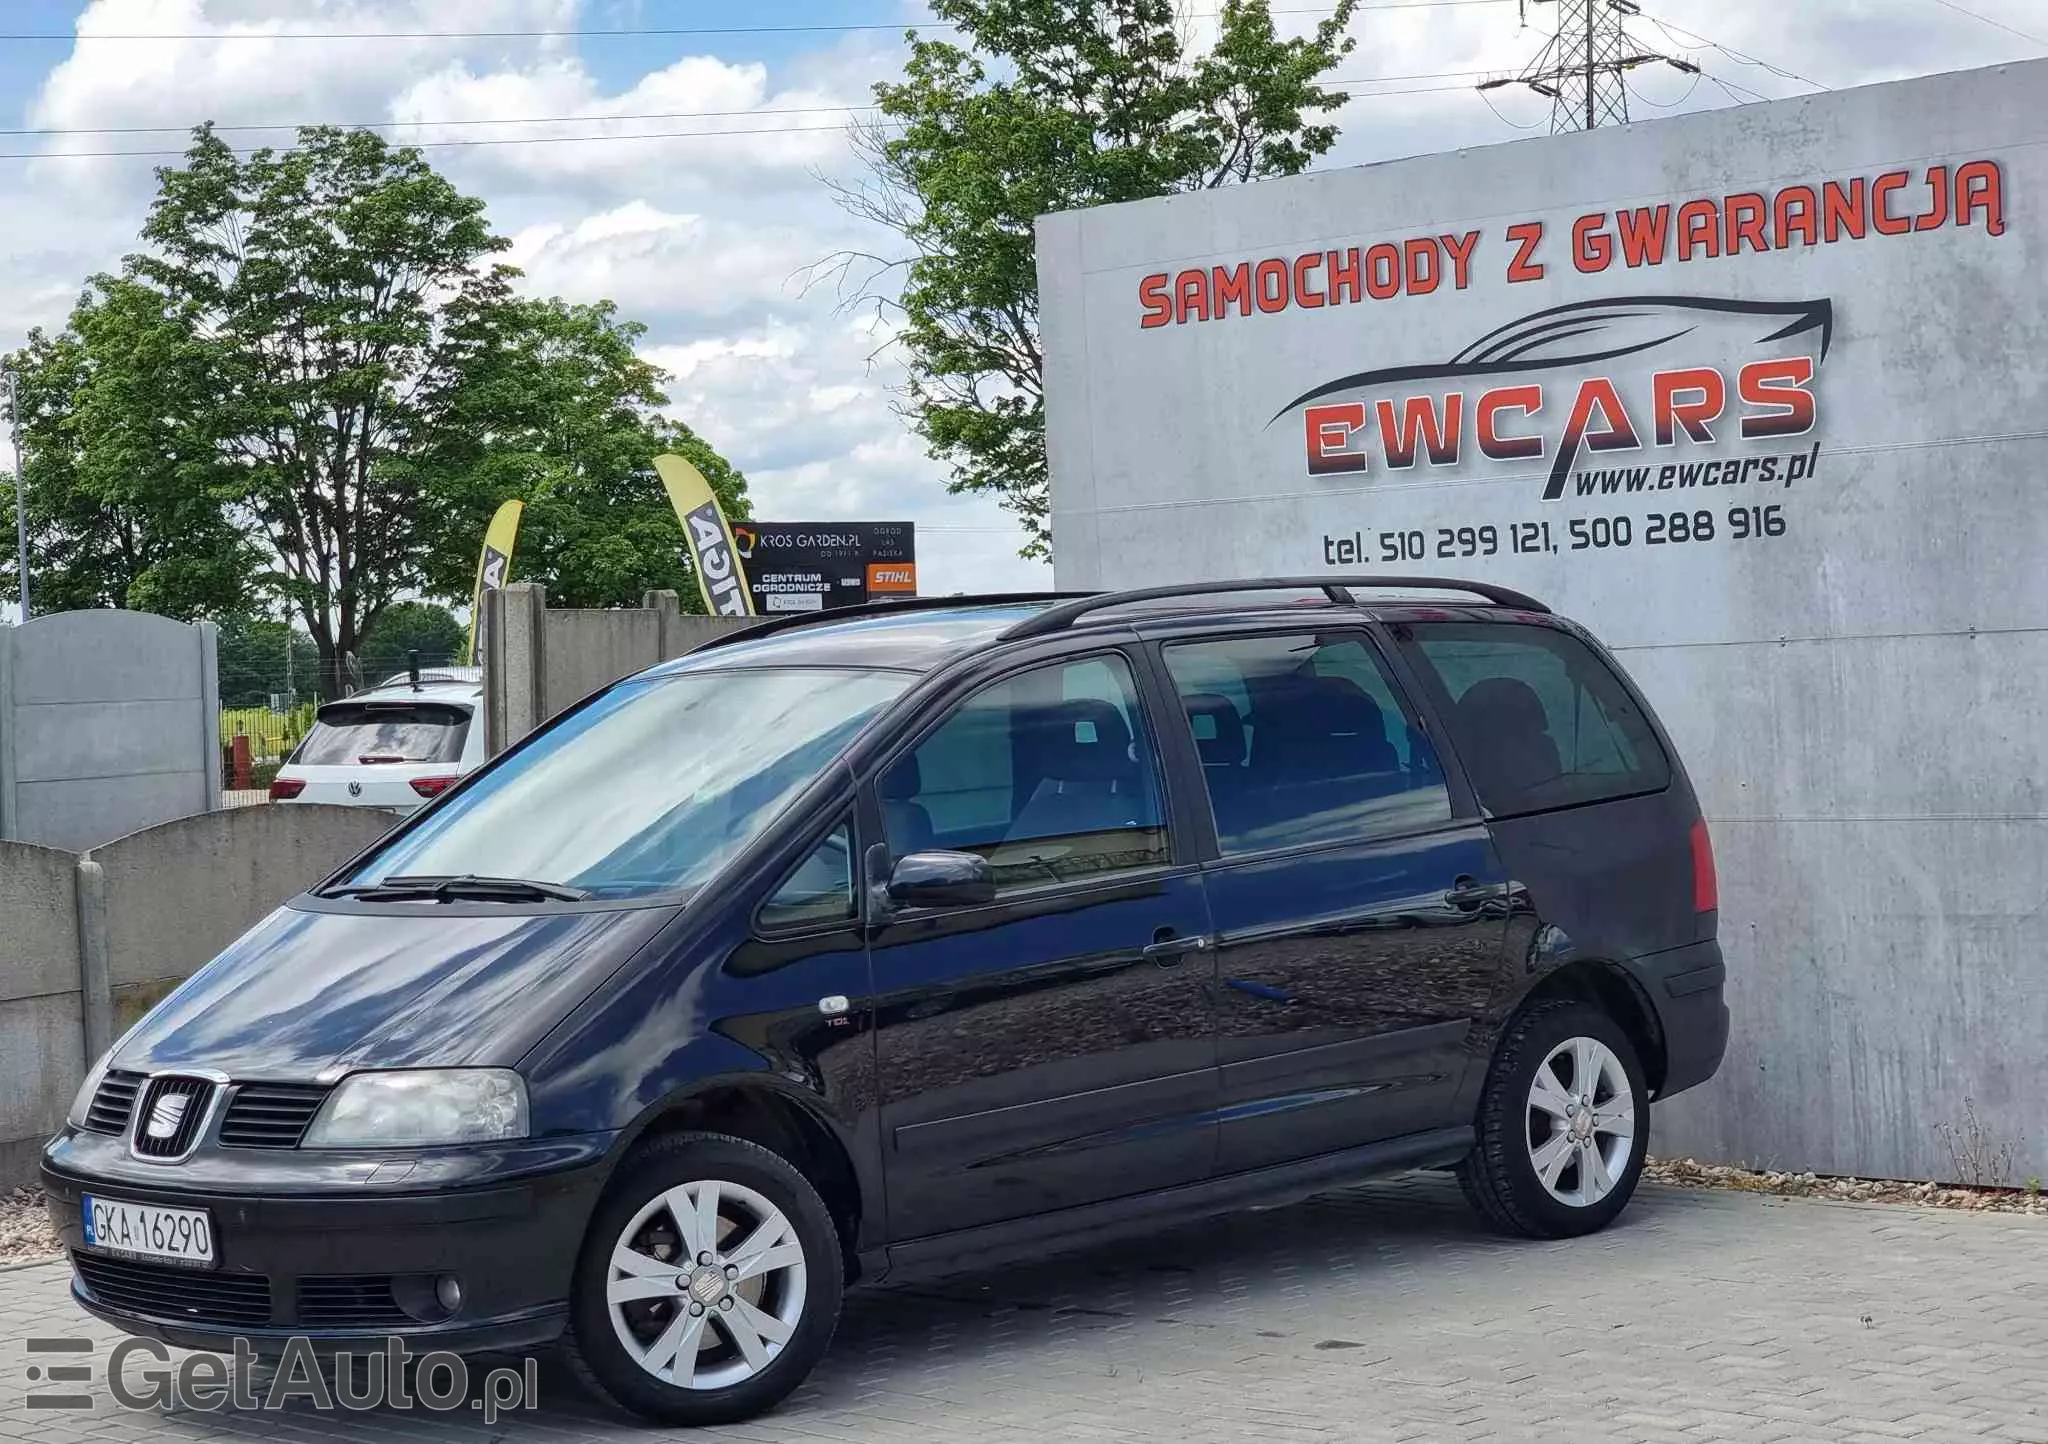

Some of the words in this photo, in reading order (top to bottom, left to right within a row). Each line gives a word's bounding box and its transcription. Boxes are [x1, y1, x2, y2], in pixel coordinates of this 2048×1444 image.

[1139, 230, 1480, 329] SAMOCHODY
[1506, 221, 1544, 283] Z
[1572, 160, 2005, 274] GWARANCJĄ
[1304, 356, 1816, 501] EWCARS
[1575, 441, 1821, 497] www.ewcars.pl
[760, 535, 793, 548] KROS
[796, 534, 861, 548] GARDEN.PL
[1323, 534, 1369, 566] tel.
[1380, 530, 1425, 562] 510
[1437, 525, 1498, 558] 299
[1509, 521, 1559, 556] 121,
[1569, 515, 1632, 550] 500
[1645, 510, 1715, 545] 288
[1728, 505, 1786, 540] 916
[752, 583, 831, 593] OGRODNICZE
[762, 573, 822, 583] CENTRUM
[875, 571, 912, 583] STIHL
[93, 1203, 132, 1246] GKA
[139, 1210, 209, 1255] 16290
